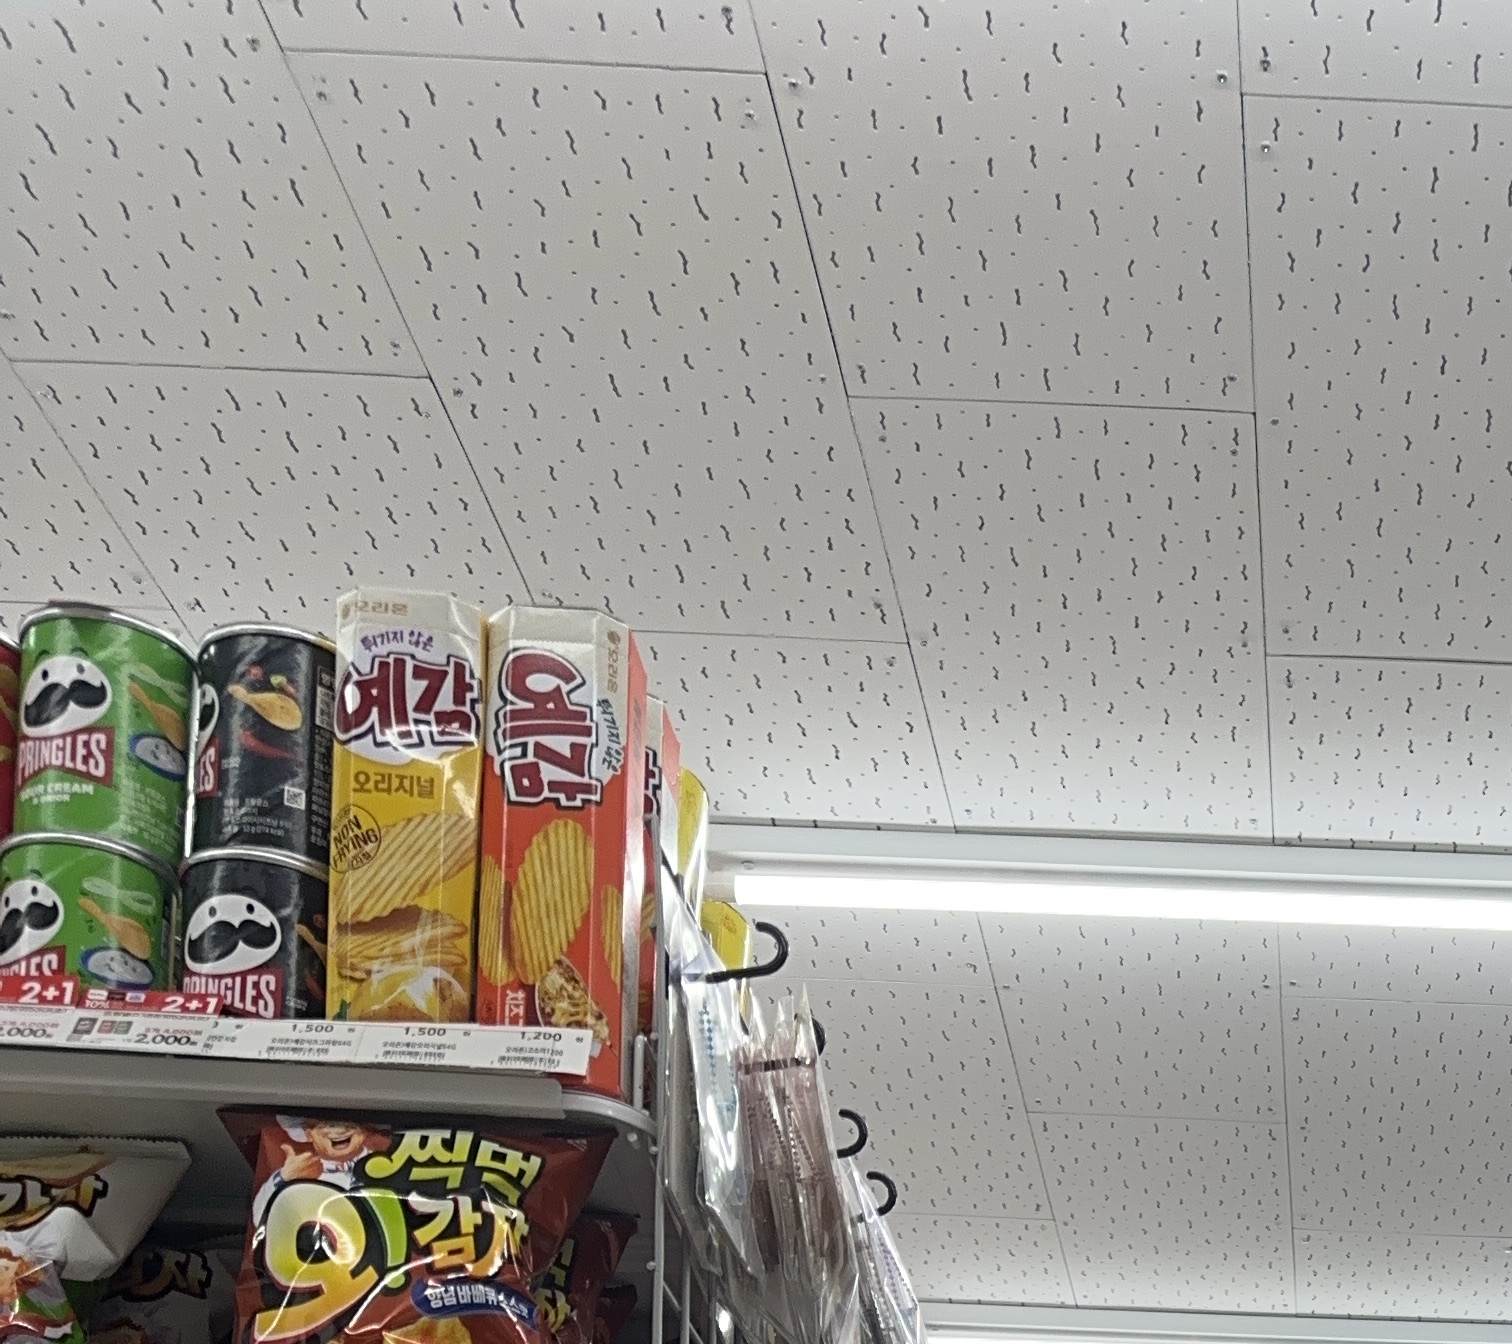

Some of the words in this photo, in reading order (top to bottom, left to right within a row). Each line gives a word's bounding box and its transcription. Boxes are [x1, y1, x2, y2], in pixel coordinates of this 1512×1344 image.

[360, 630, 404, 652] 튀기지
[408, 630, 436, 652] 않은
[337, 654, 479, 746] 예감
[500, 650, 600, 808] 예감
[17, 732, 108, 786] PRINGLES
[352, 771, 436, 800] 오리지널
[332, 814, 363, 850] NON
[20, 982, 76, 1005] 2+1
[160, 996, 219, 1014] 2+1
[135, 1033, 190, 1047] 2,000
[291, 1024, 335, 1034] 1,500
[403, 1027, 447, 1038] 1,500
[519, 1031, 562, 1043] 1,200
[364, 1128, 542, 1207] 찍먹
